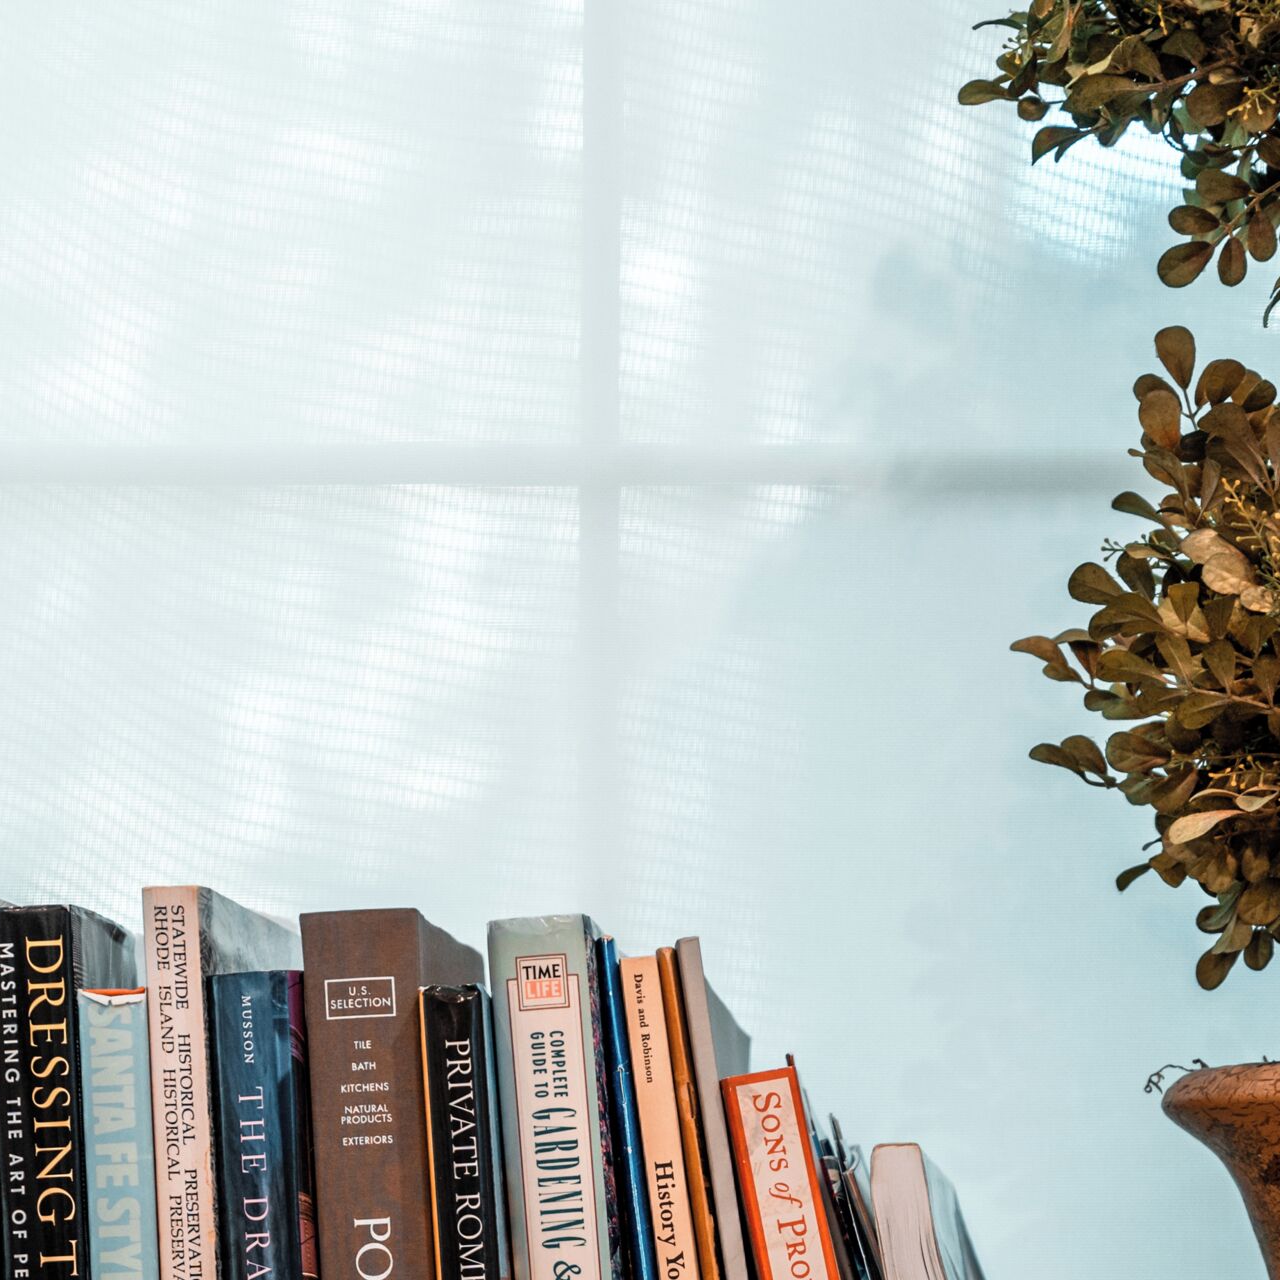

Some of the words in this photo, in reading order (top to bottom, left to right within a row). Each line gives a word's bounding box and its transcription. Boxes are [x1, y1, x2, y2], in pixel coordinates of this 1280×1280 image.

[153, 905, 171, 970] RHODE
[170, 904, 190, 1010] STATEWIDE
[348, 985, 371, 997] U.S.
[522, 963, 561, 981] TIME
[525, 980, 561, 999] LIFE
[633, 973, 643, 1005] Davis
[158, 986, 175, 1054] ISLAND
[330, 996, 391, 1009] SELECTION
[638, 1008, 649, 1029] and
[240, 994, 255, 1065] MUSSON
[353, 1039, 372, 1050] TILE
[87, 1003, 138, 1136] SANTA
[351, 1060, 376, 1072] BATH
[529, 1032, 547, 1076] GUIDE
[549, 1030, 569, 1098] COMPLETE
[640, 1033, 654, 1084] Robinson
[24, 935, 77, 1227] DRESSING
[177, 1033, 197, 1146] HISTORICAL
[340, 1081, 389, 1094] KITCHENS
[533, 1081, 549, 1099] TO
[6, 1097, 24, 1140] THE
[162, 1069, 182, 1181] HISTORICAL
[237, 1086, 268, 1175] THE
[340, 1113, 393, 1125] PRODUCTS
[344, 1103, 389, 1115] NATURAL
[444, 1038, 479, 1181] PRIVATE
[342, 1134, 394, 1147] EXTERIORS
[752, 1090, 789, 1173] SONS
[8, 1153, 26, 1195] ART
[95, 1141, 140, 1190] FE
[530, 1106, 587, 1250] GARDENING
[653, 1160, 677, 1247] History
[768, 1181, 803, 1211] of
[11, 1210, 28, 1239] OF
